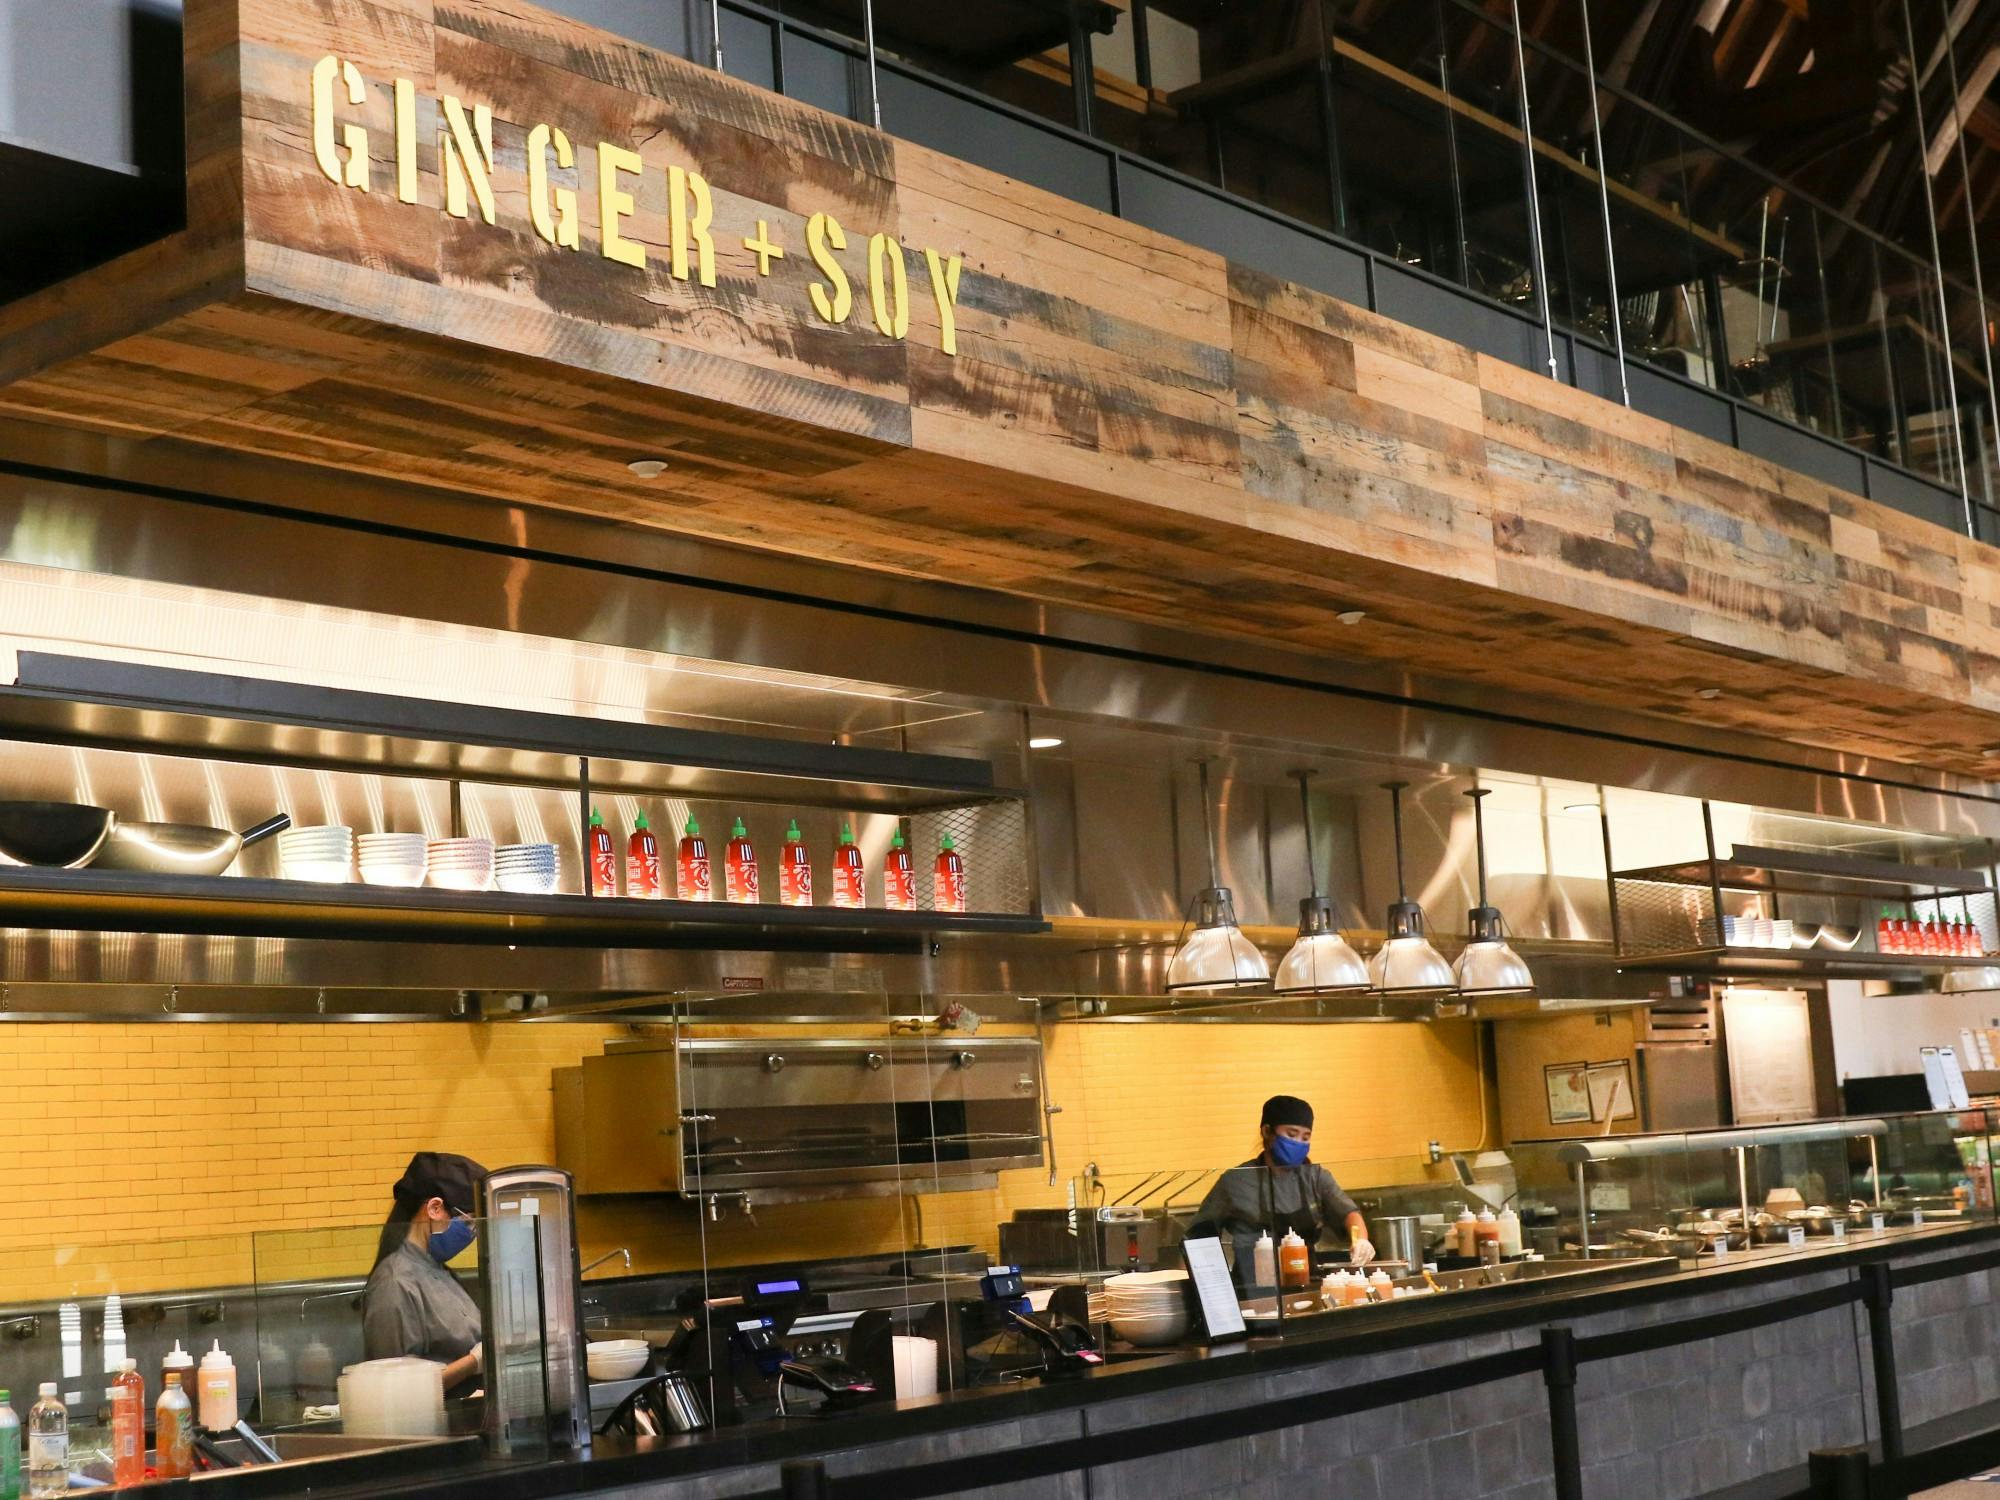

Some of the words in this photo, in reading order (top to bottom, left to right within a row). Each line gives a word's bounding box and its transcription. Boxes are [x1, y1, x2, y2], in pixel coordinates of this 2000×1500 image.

[312, 54, 718, 288] GINGER
[743, 219, 784, 277] +
[806, 211, 963, 357] SOY
